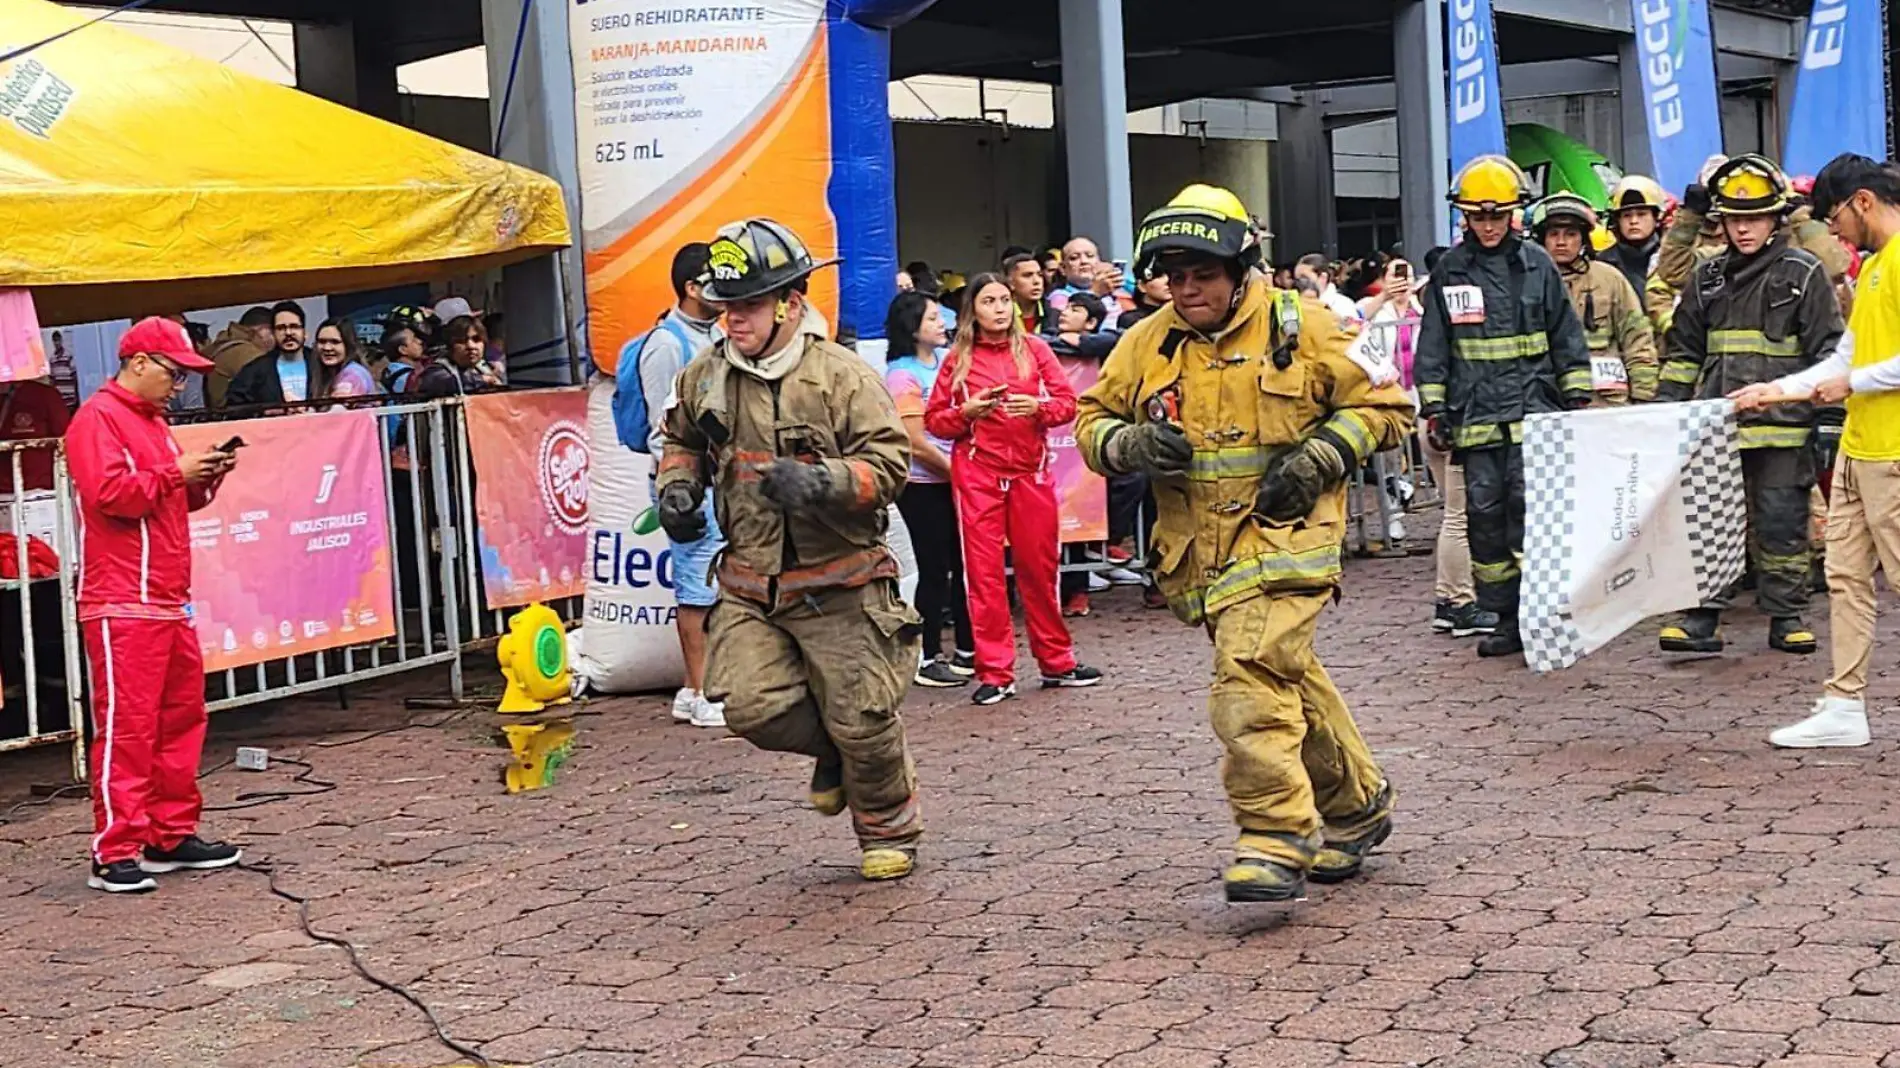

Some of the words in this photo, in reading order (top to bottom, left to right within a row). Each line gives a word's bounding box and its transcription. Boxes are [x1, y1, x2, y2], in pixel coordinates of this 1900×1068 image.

[591, 14, 630, 32] SUERO
[635, 7, 765, 26] REHIDRATANTE
[591, 37, 767, 61] NARANJA-MANDARINA
[596, 142, 626, 163] 625
[633, 138, 664, 160] mL
[1144, 222, 1218, 242] BECERRA
[289, 512, 368, 535] INDUSTRIALES
[306, 533, 351, 551] JALISCO
